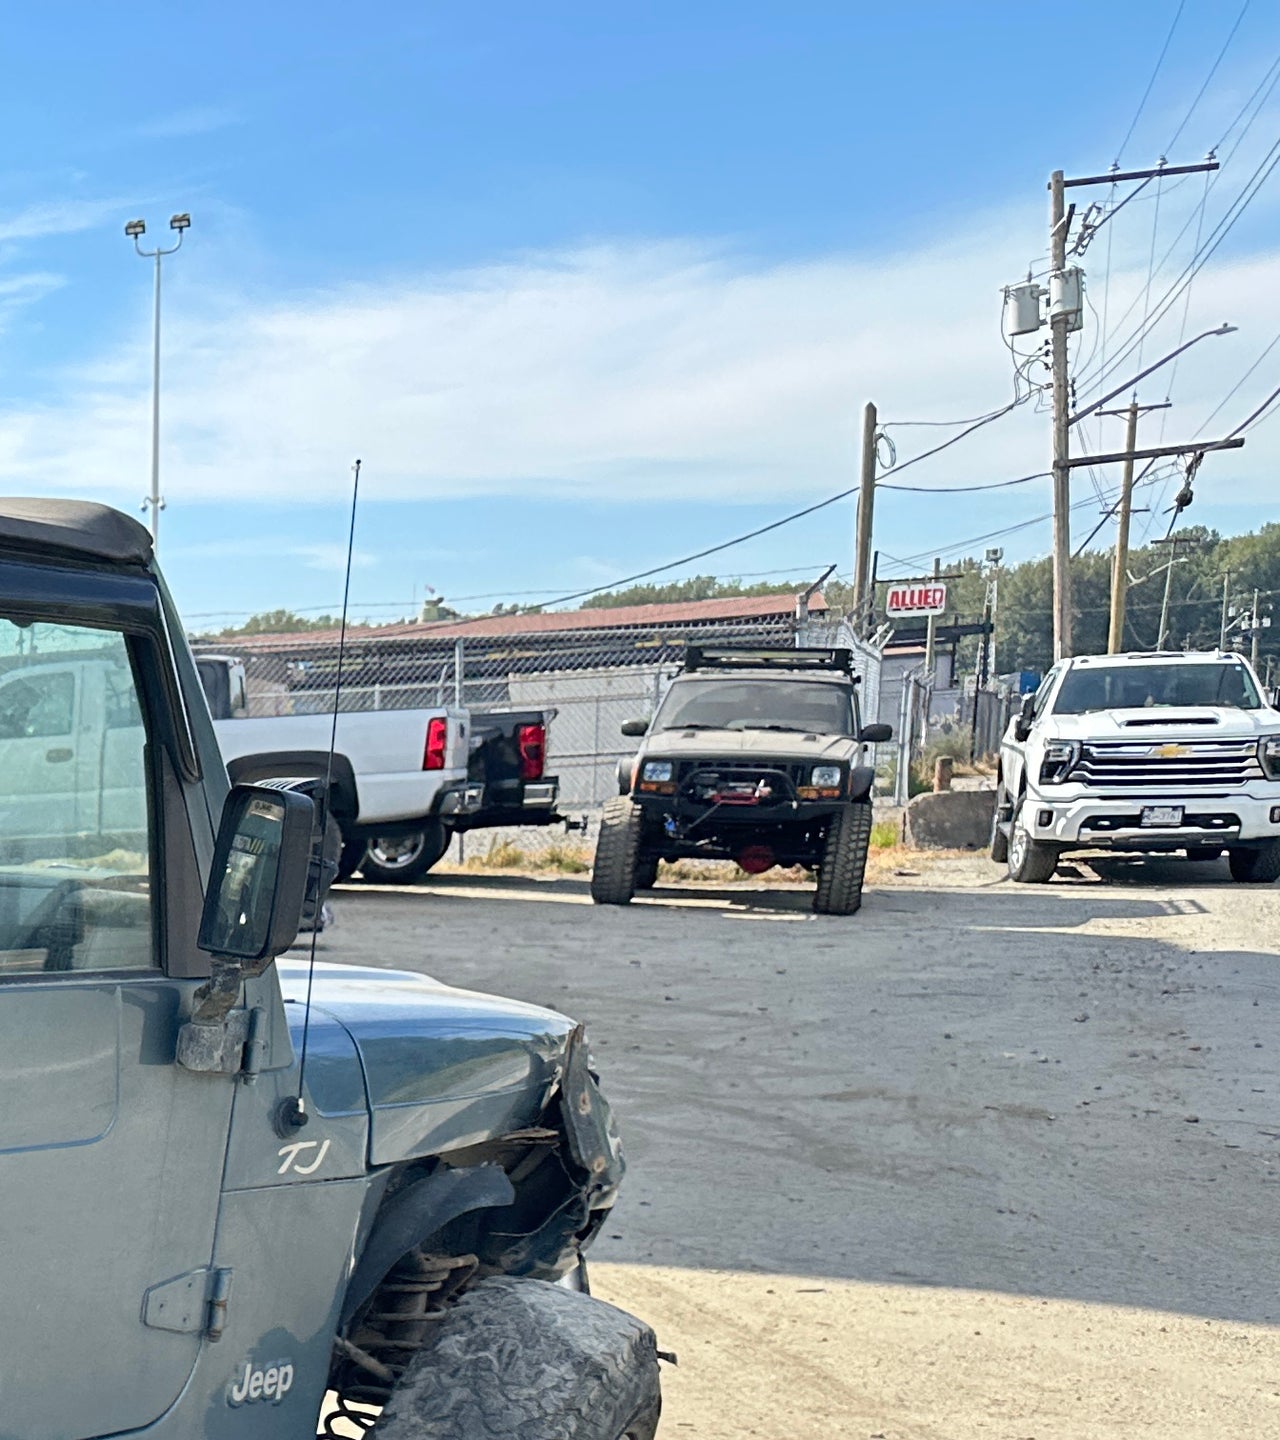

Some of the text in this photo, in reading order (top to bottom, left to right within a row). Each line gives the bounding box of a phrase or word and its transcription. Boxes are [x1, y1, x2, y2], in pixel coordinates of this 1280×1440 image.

[889, 588, 944, 607] ALLIED
[278, 1139, 331, 1174] TJ
[231, 1363, 294, 1402] Jeep
